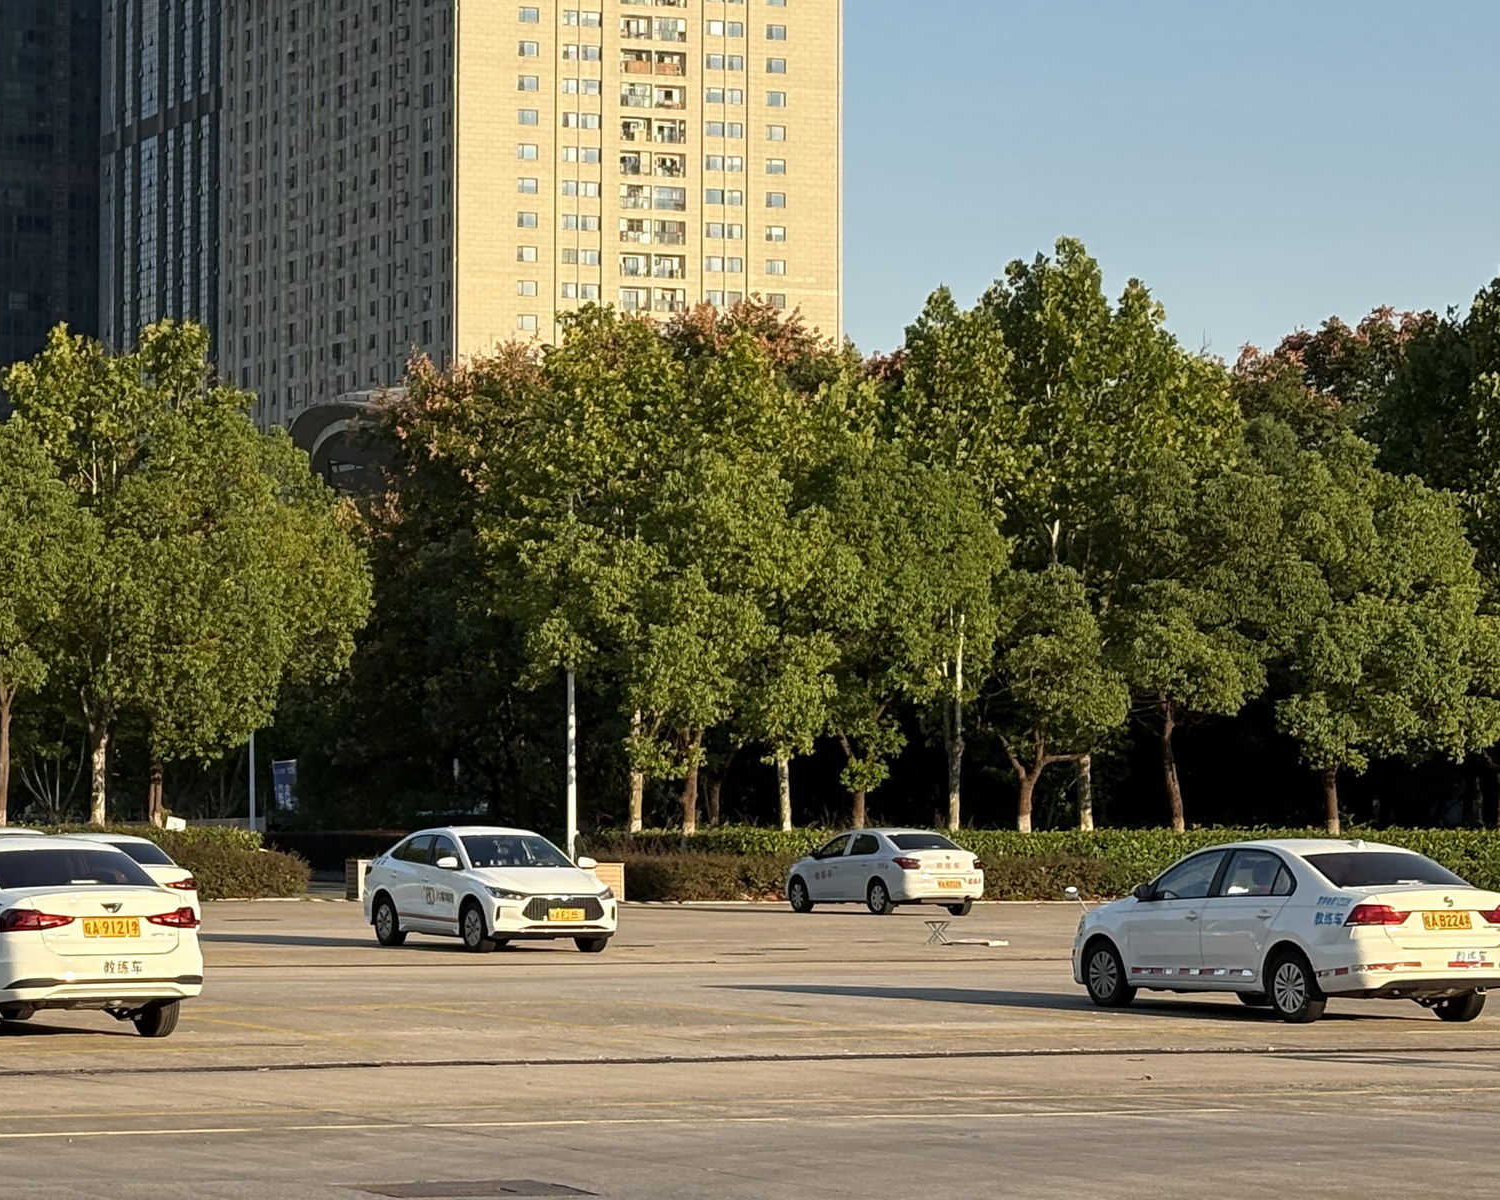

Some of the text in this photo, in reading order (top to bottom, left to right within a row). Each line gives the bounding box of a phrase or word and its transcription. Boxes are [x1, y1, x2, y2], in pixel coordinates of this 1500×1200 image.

[1315, 911, 1343, 925] 教练车
[103, 960, 142, 974] 教练车
